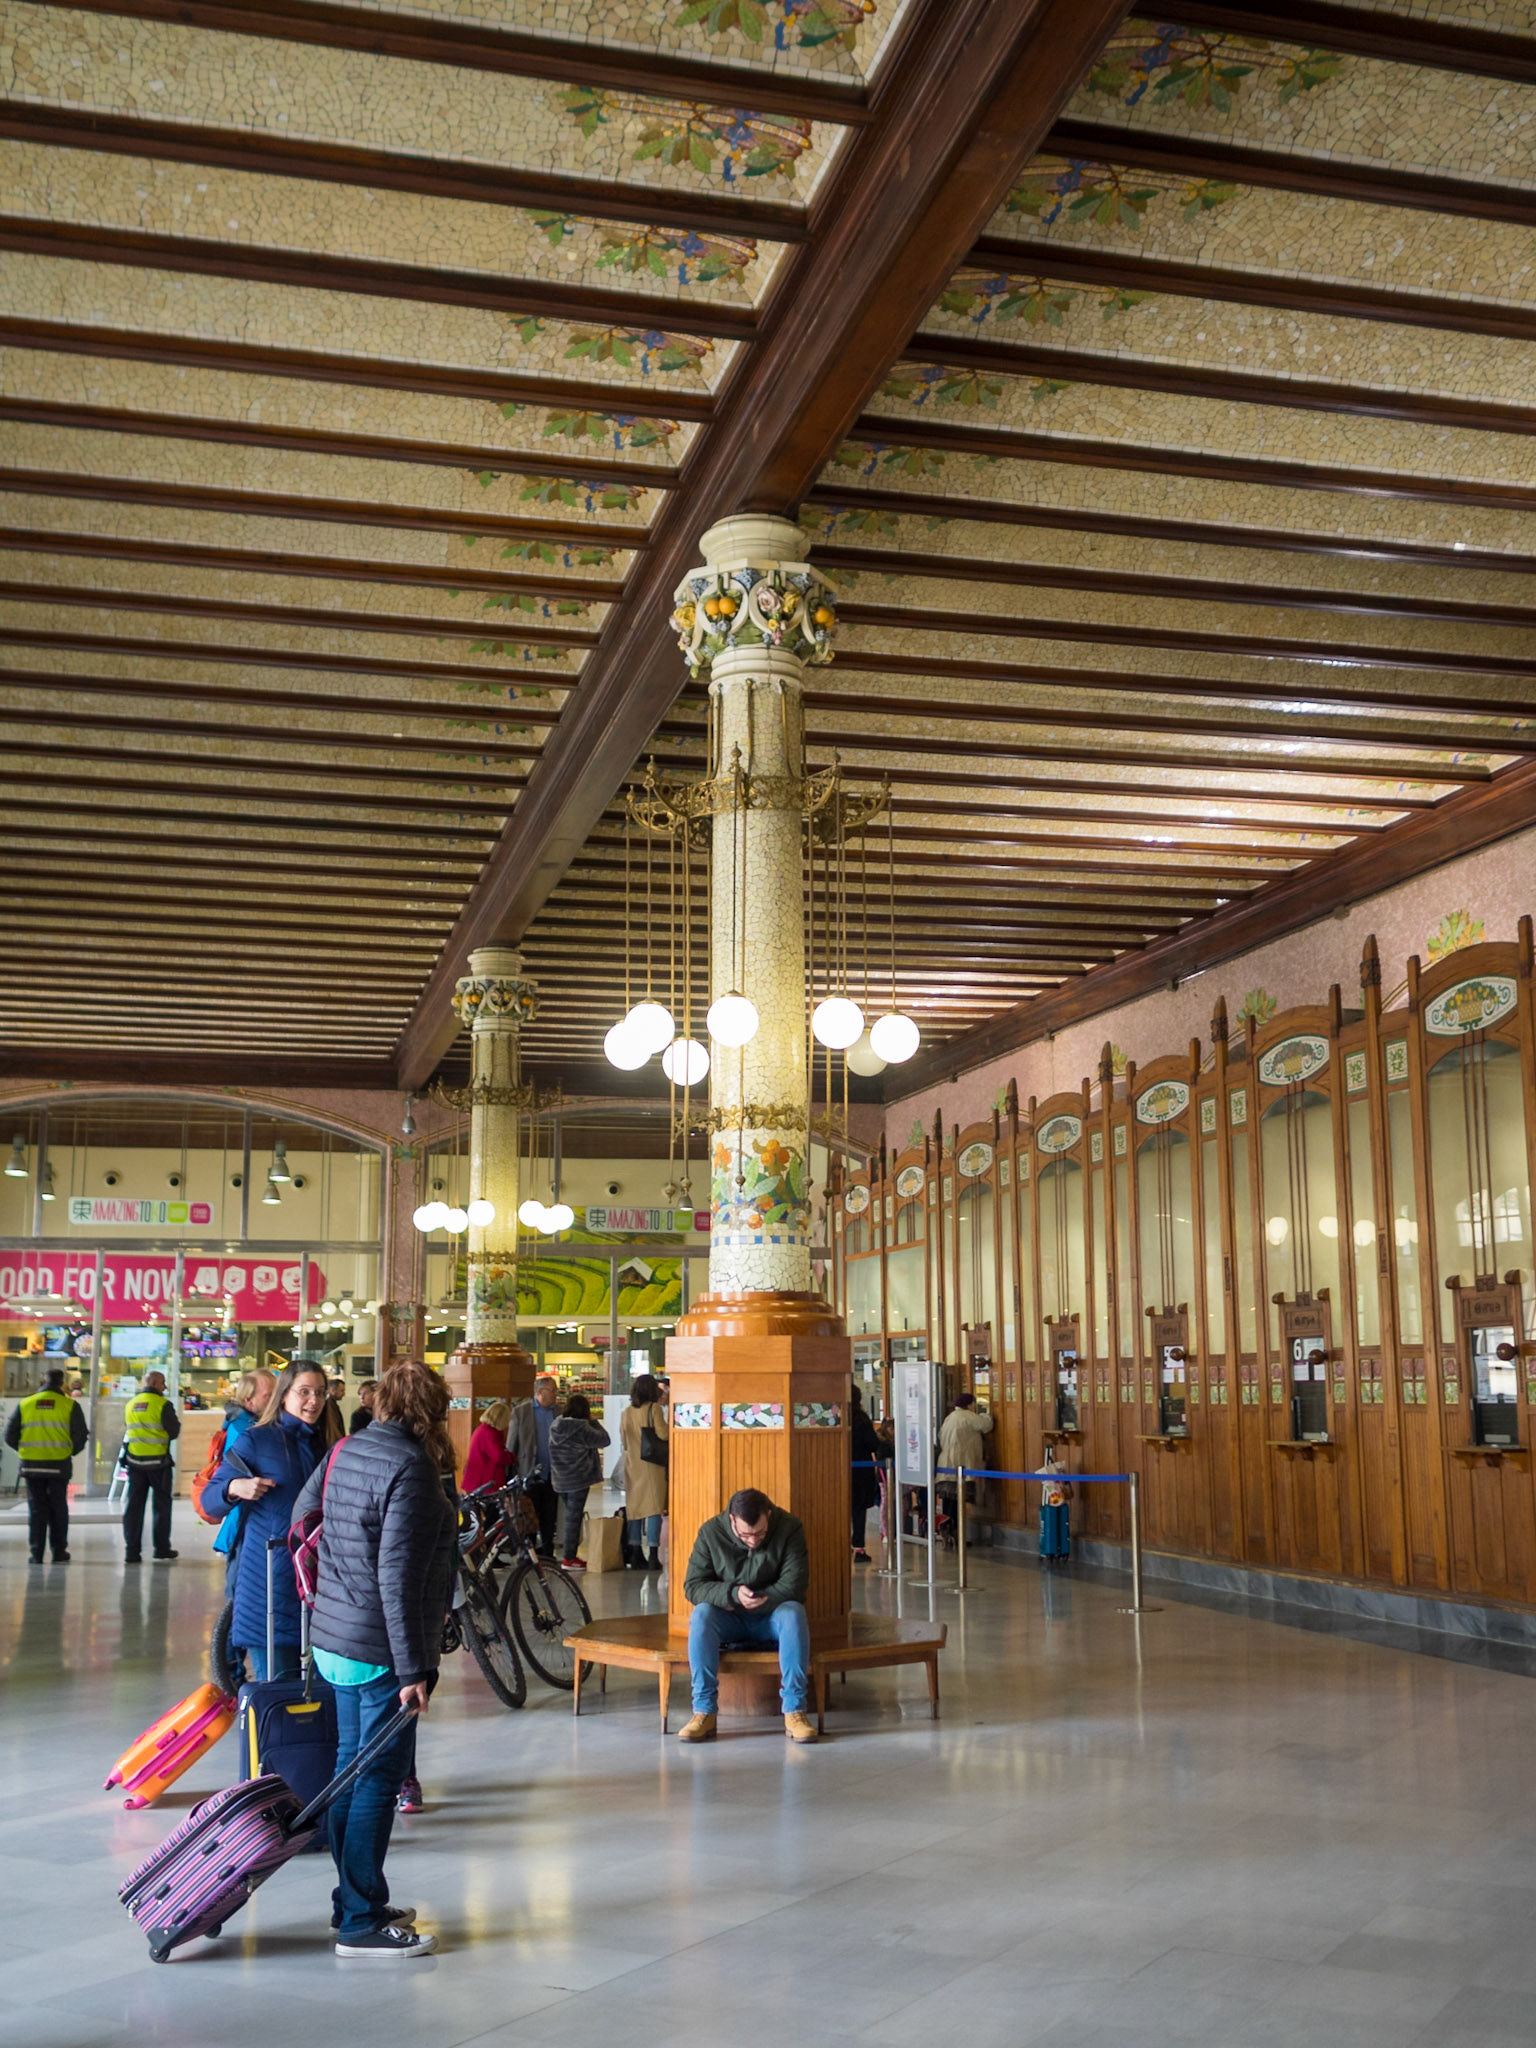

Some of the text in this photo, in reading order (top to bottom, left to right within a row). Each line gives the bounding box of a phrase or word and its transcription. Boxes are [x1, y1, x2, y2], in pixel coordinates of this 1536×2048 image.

[63, 1267, 116, 1300] FOR
[123, 1268, 186, 1301] NOW
[1293, 1338, 1303, 1361] 6
[1472, 1329, 1484, 1354] 7
